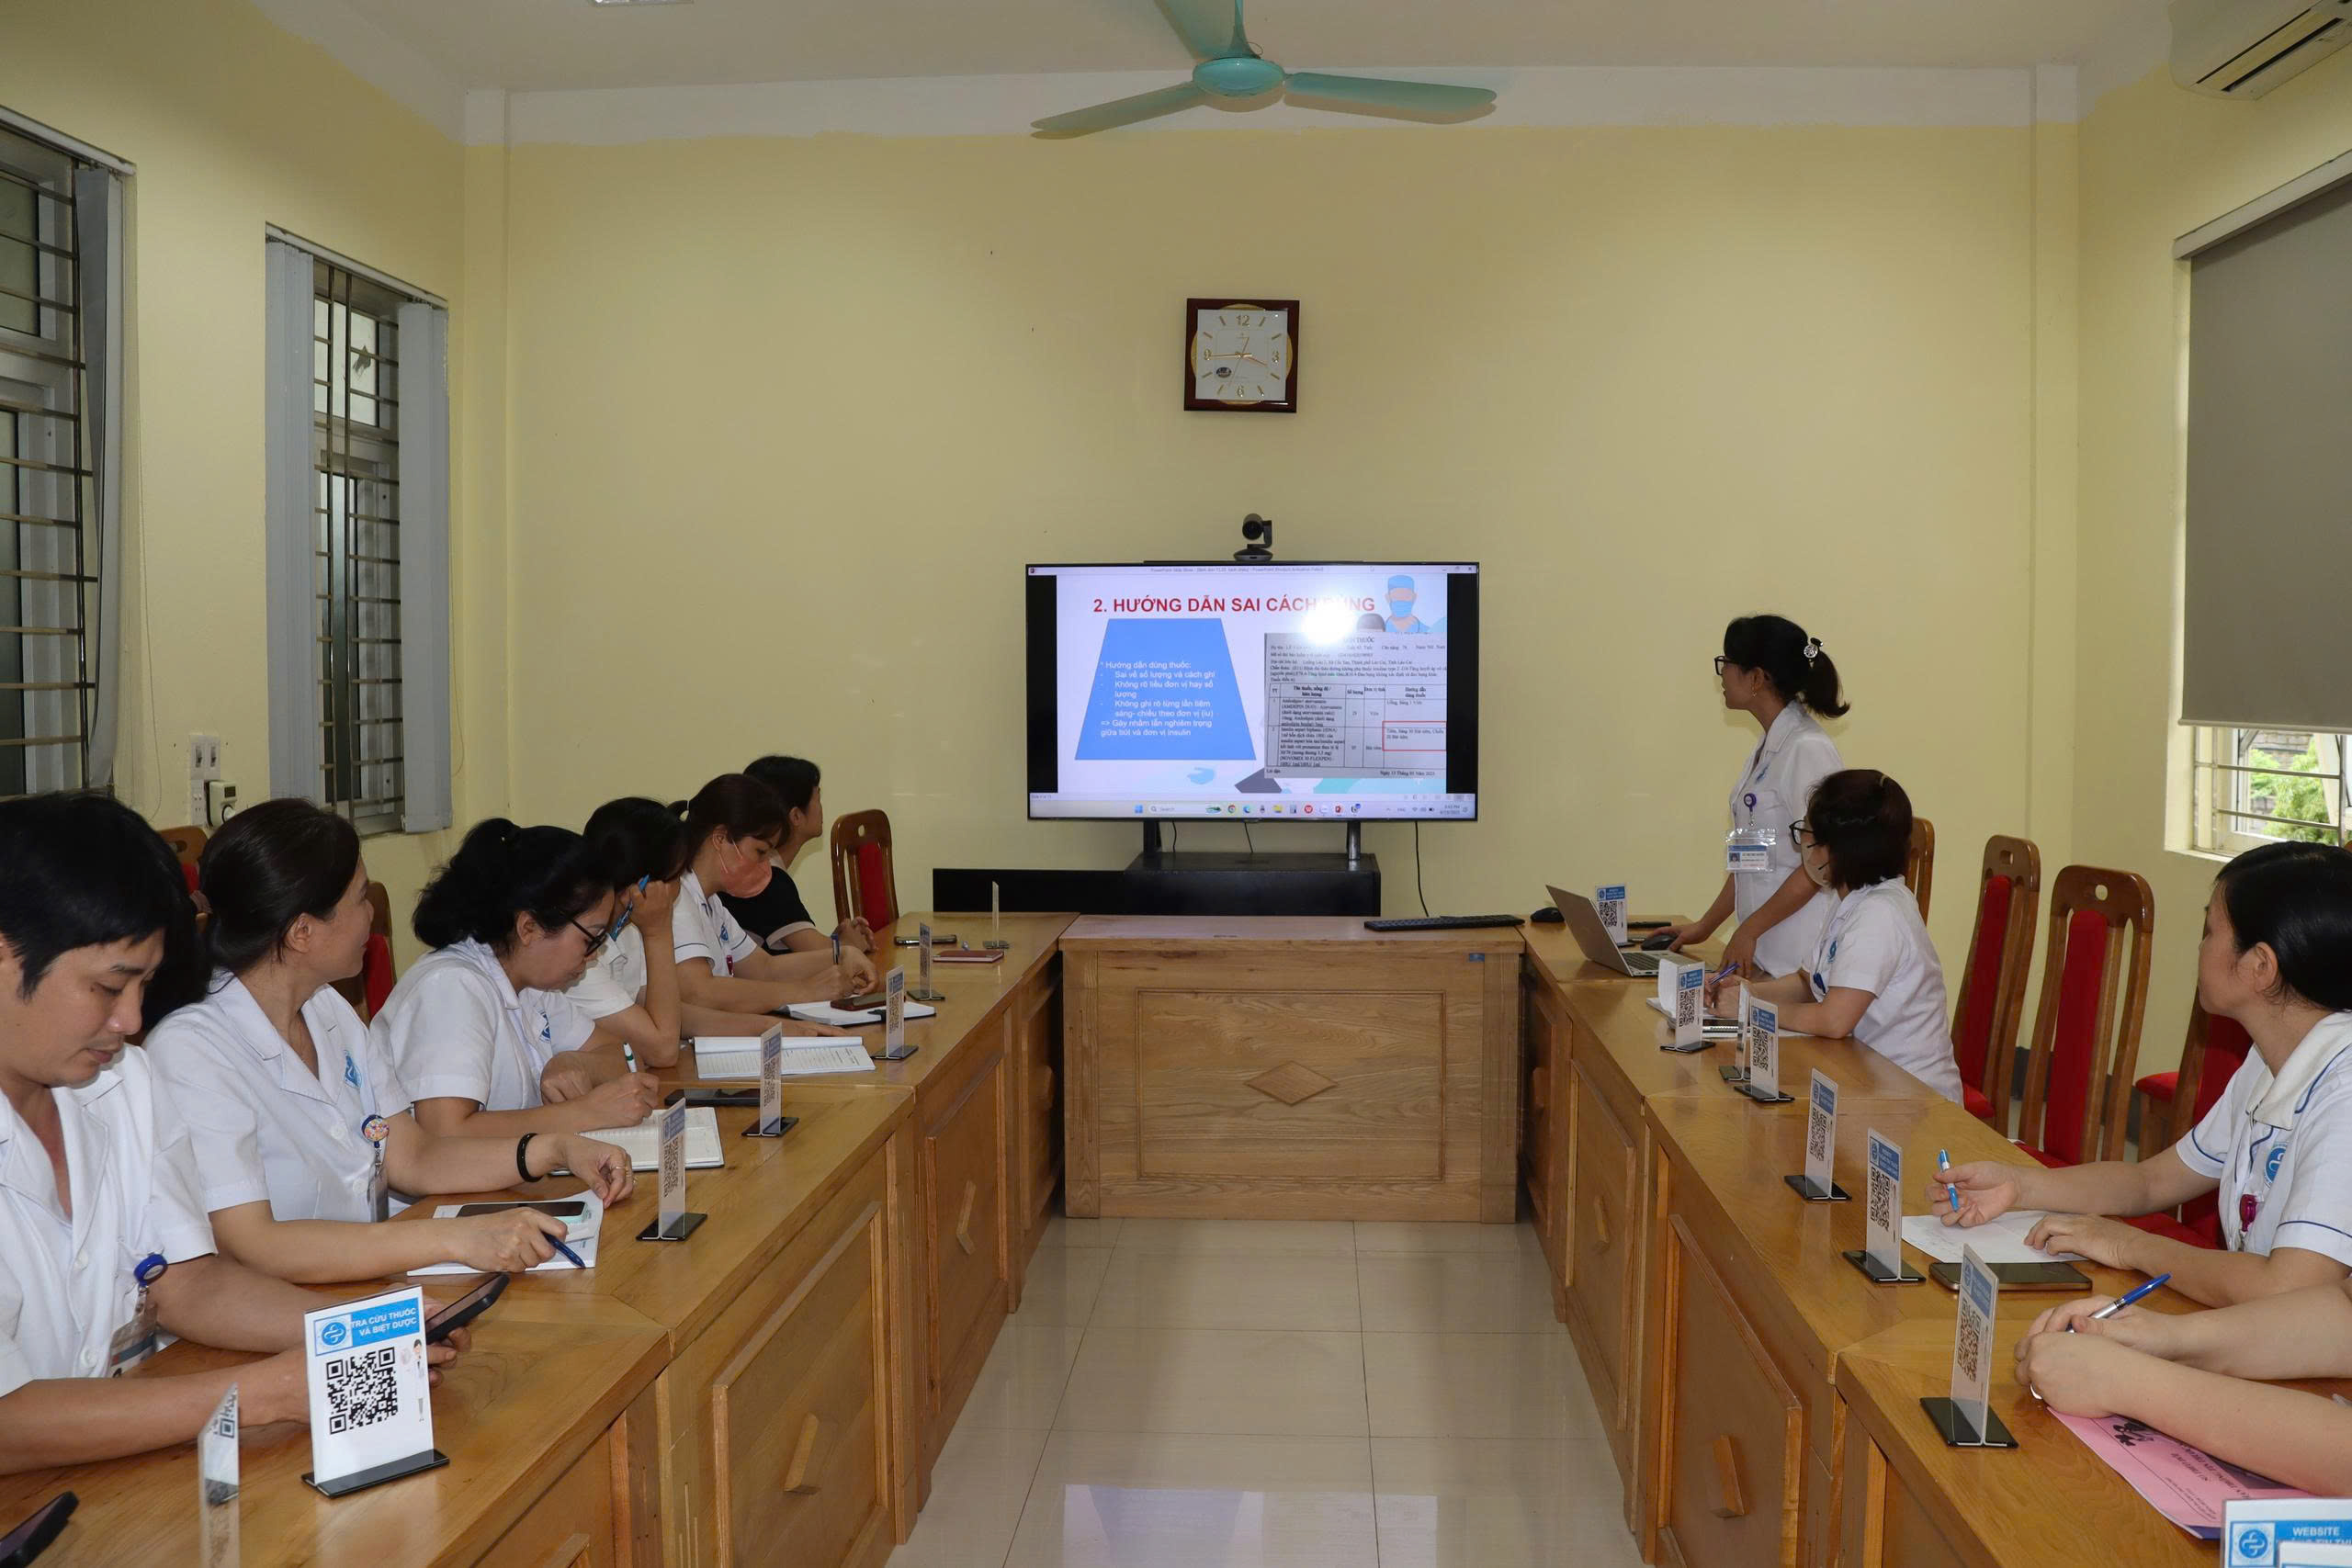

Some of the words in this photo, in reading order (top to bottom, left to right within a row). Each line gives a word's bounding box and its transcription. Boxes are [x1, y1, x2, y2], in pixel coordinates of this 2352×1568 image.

[1236, 315, 1250, 326] 12
[1204, 349, 1212, 360] 9
[1272, 351, 1280, 362] 3
[1237, 386, 1245, 397] 6
[1093, 598, 1107, 612] 2.
[1113, 594, 1182, 612] HƯỚNG
[1188, 594, 1225, 612] DẪN
[1231, 597, 1260, 612] SAI
[1266, 593, 1317, 612] CÁCH
[1106, 660, 1131, 670] Hướng
[1148, 661, 1167, 670] dùng
[1169, 660, 1192, 669] thuốc:
[1114, 681, 1138, 689] Không
[1150, 680, 1162, 688] liều
[1189, 681, 1203, 689] hay
[1204, 680, 1214, 688] số
[1114, 691, 1136, 699] lượng
[1136, 709, 1157, 717] chiều
[1201, 710, 1213, 718] (iu)
[1112, 719, 1127, 728] Gây
[1128, 718, 1149, 727] nhầm
[1101, 729, 1117, 738] giữa
[351, 1319, 368, 1328] TRA
[388, 1307, 417, 1320] THUỐC
[359, 1325, 371, 1337] VÀ
[372, 1323, 391, 1334] BIỆT
[2292, 1526, 2340, 1537] WEBSITE
